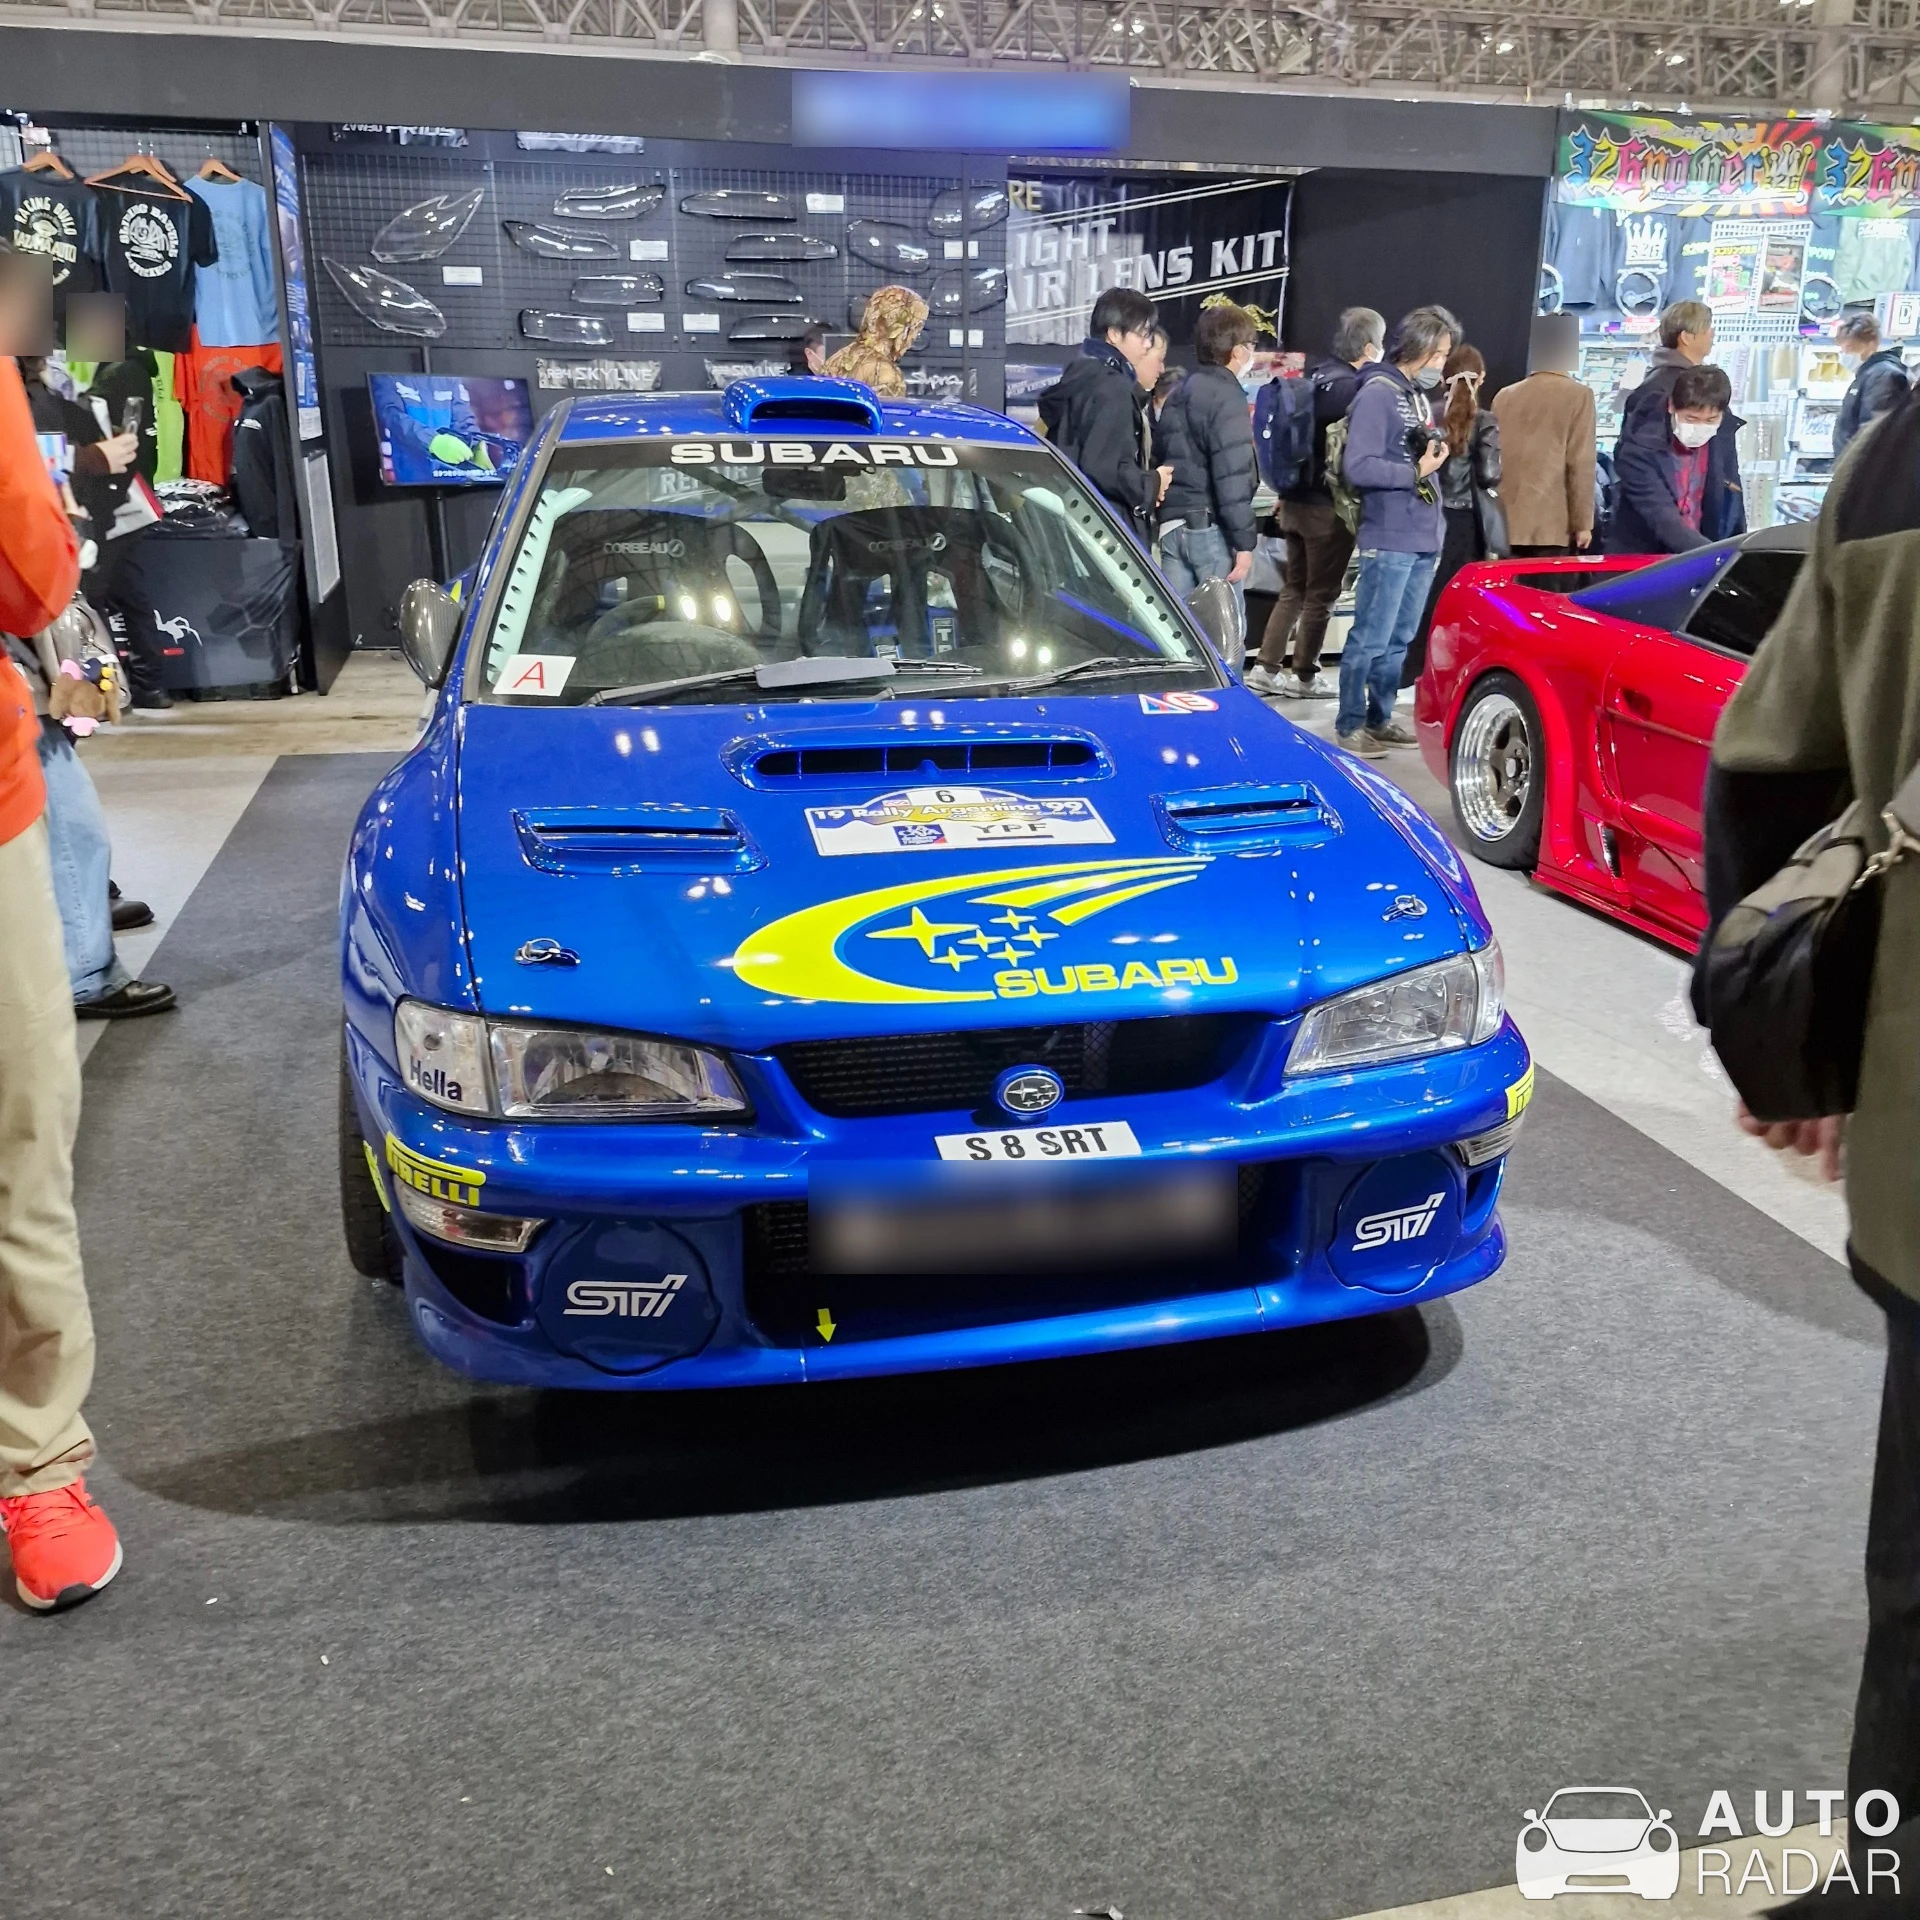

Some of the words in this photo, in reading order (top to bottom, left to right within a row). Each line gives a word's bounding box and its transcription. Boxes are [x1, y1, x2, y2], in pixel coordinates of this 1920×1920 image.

[1006, 217, 1117, 270] IGHT
[1088, 246, 1193, 297] LENS
[1210, 229, 1283, 278] KIT
[575, 366, 653, 381] SKYLINE
[731, 364, 785, 377] SKYLINE
[911, 370, 964, 390] Supra
[670, 442, 959, 467] SUBARU
[603, 542, 669, 554] CORBEAU
[511, 661, 545, 690] A
[935, 790, 955, 803] 6
[815, 810, 845, 821] 19
[852, 806, 913, 818] Rally
[920, 802, 1040, 815] Argentina
[970, 823, 1047, 834] YPF
[993, 956, 1239, 999] SUBARU
[409, 1055, 463, 1101] Hella
[965, 1136, 992, 1161] S
[1000, 1134, 1026, 1159] 8
[1035, 1127, 1108, 1156] SRT
